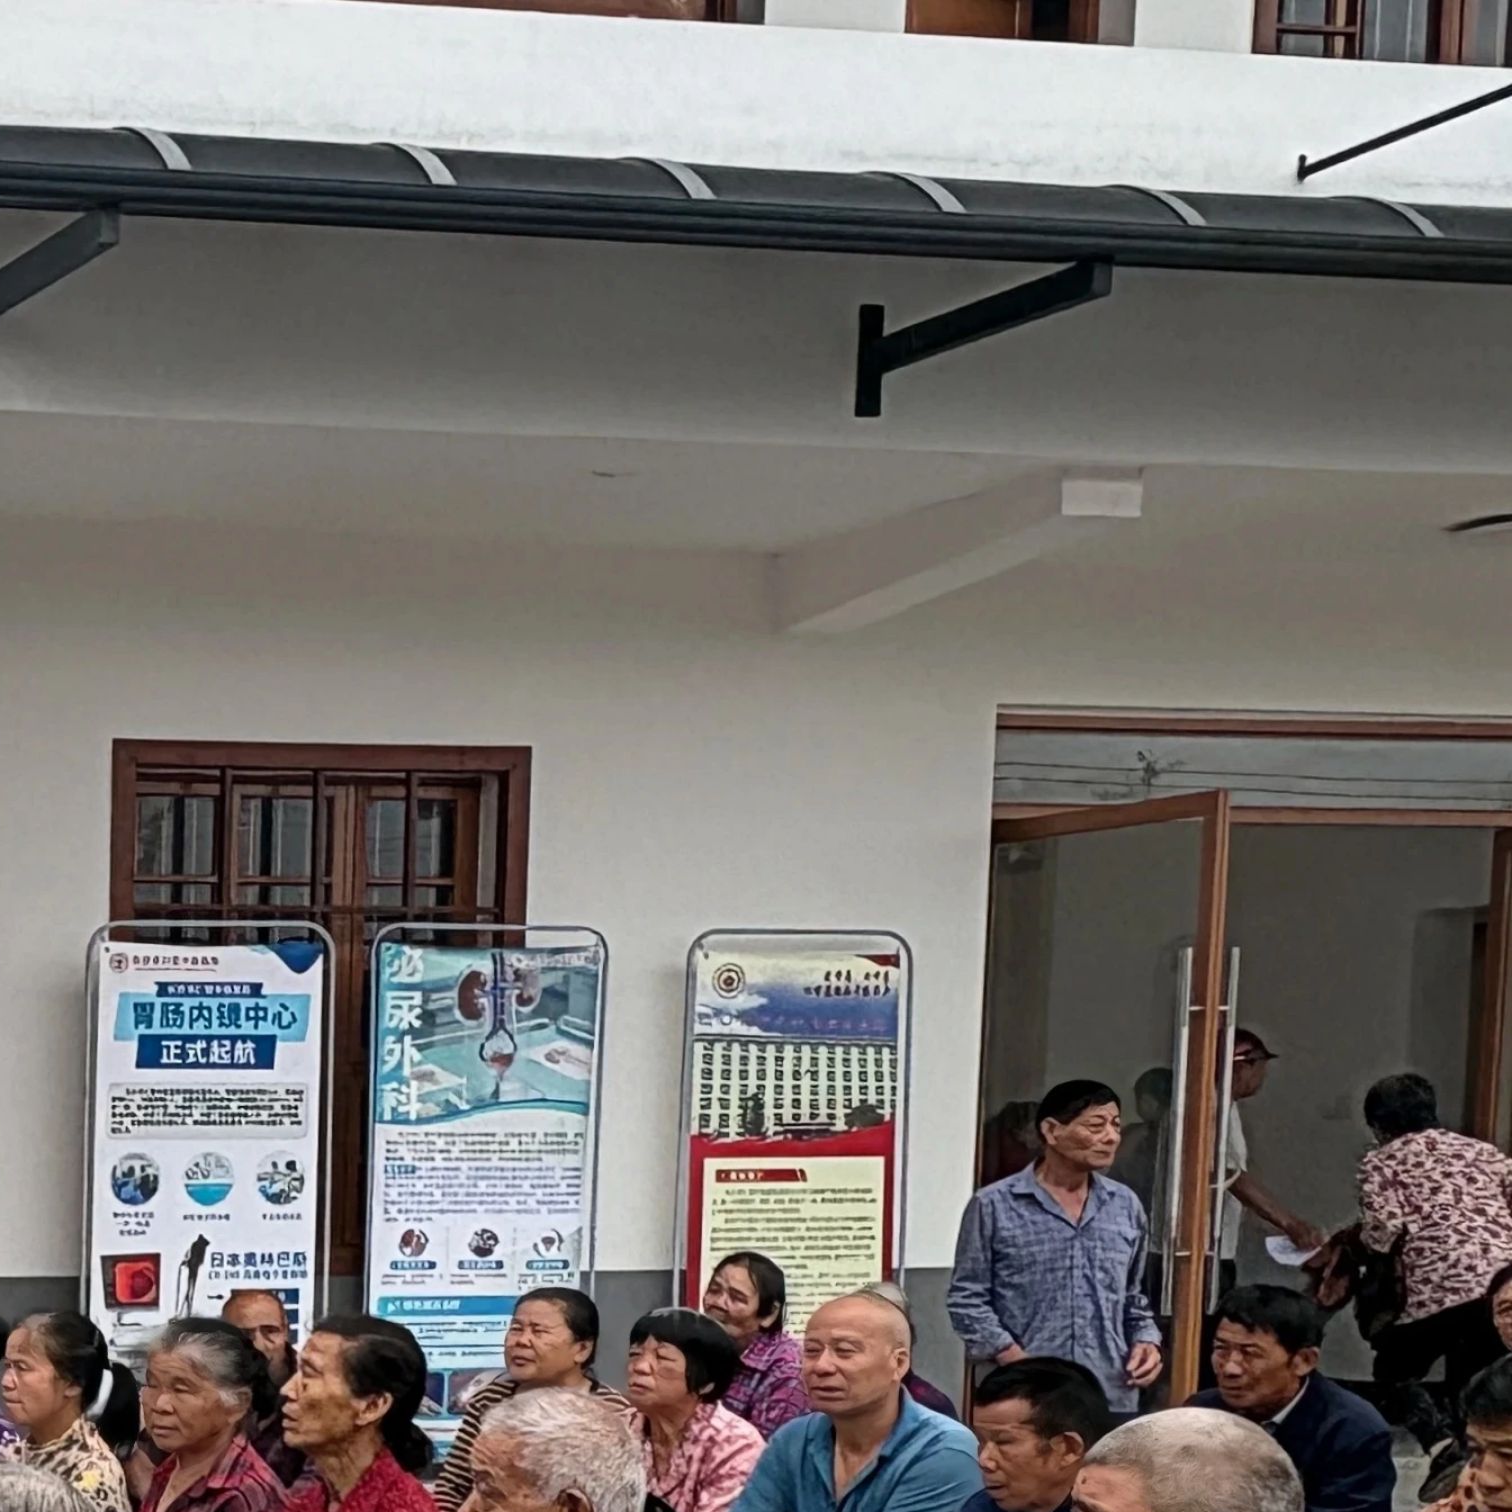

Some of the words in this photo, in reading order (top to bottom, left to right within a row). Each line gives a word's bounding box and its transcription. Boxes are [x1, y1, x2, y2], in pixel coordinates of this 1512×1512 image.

[133, 1001, 298, 1030] 胃肠内镜中心
[382, 946, 424, 1121] 泌尿外科
[160, 1039, 256, 1065] 正式起航
